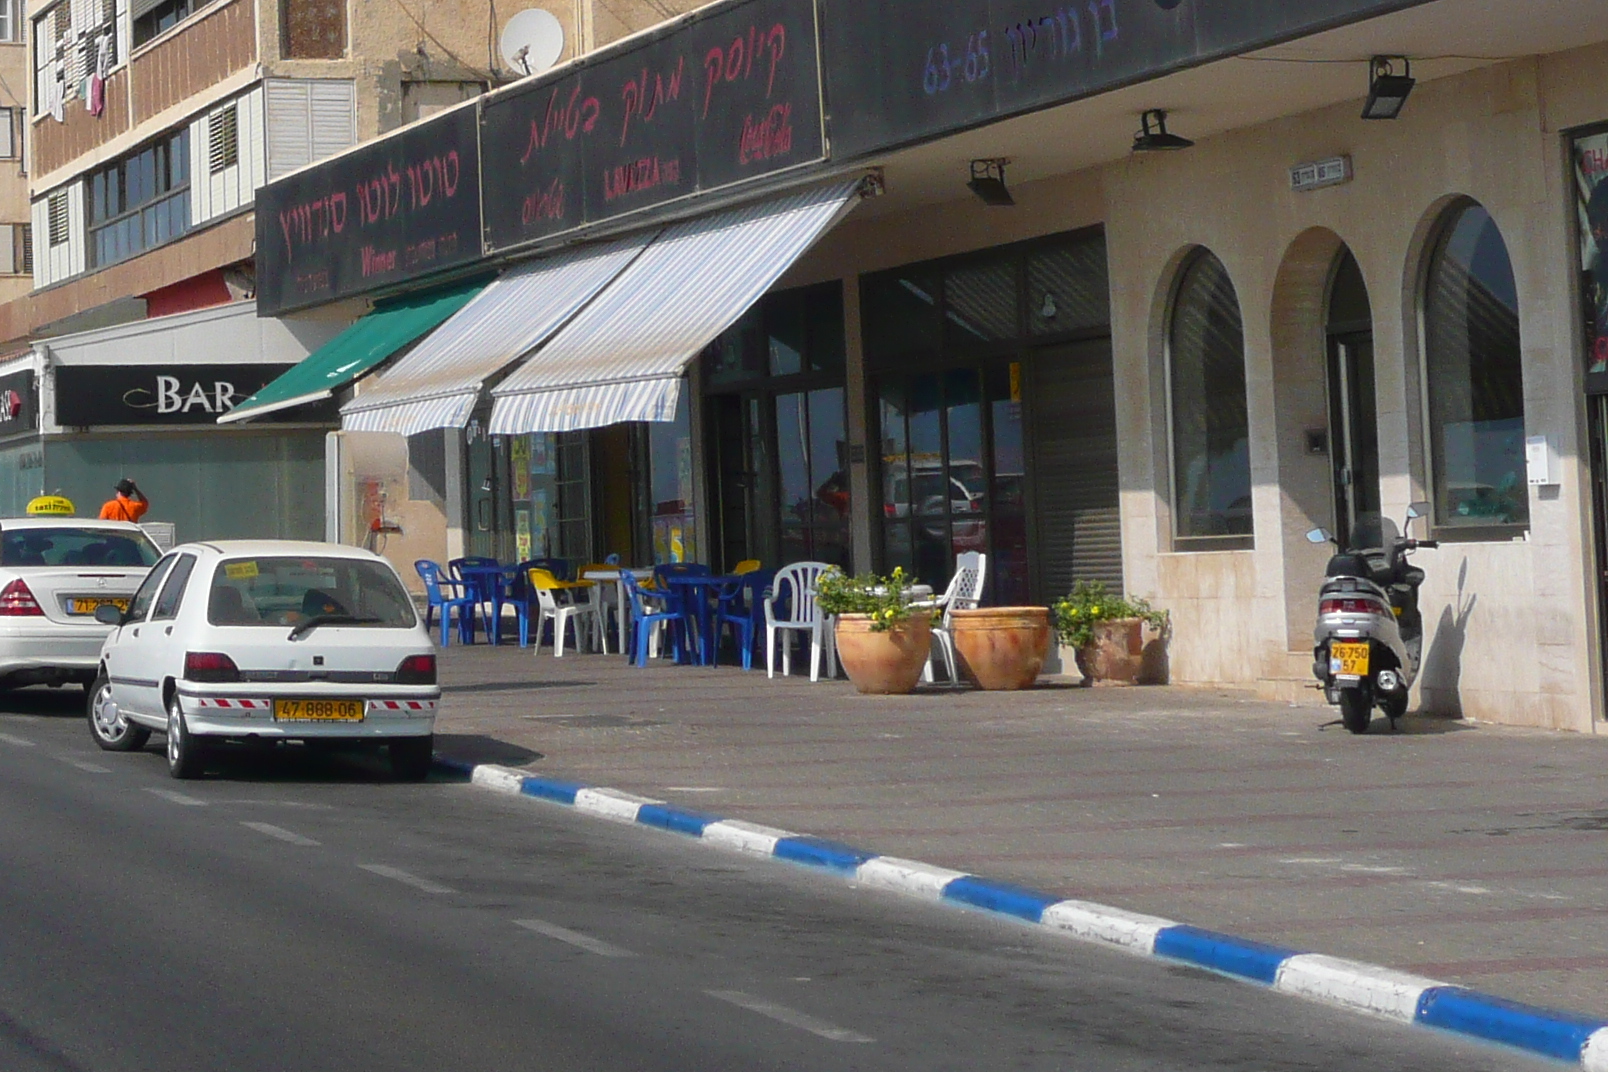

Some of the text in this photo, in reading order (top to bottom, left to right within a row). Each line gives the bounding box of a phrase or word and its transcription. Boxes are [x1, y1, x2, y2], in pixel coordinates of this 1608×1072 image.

[922, 29, 990, 95] 63-65
[1004, 5, 1082, 83] גוריון
[520, 23, 786, 166] קיוסק מתוק בטיילת
[356, 159, 400, 228] לוטו
[407, 149, 460, 211] טוטו
[604, 156, 660, 201] LAVAZZA
[360, 245, 397, 278] Winner
[156, 375, 237, 413] BAR
